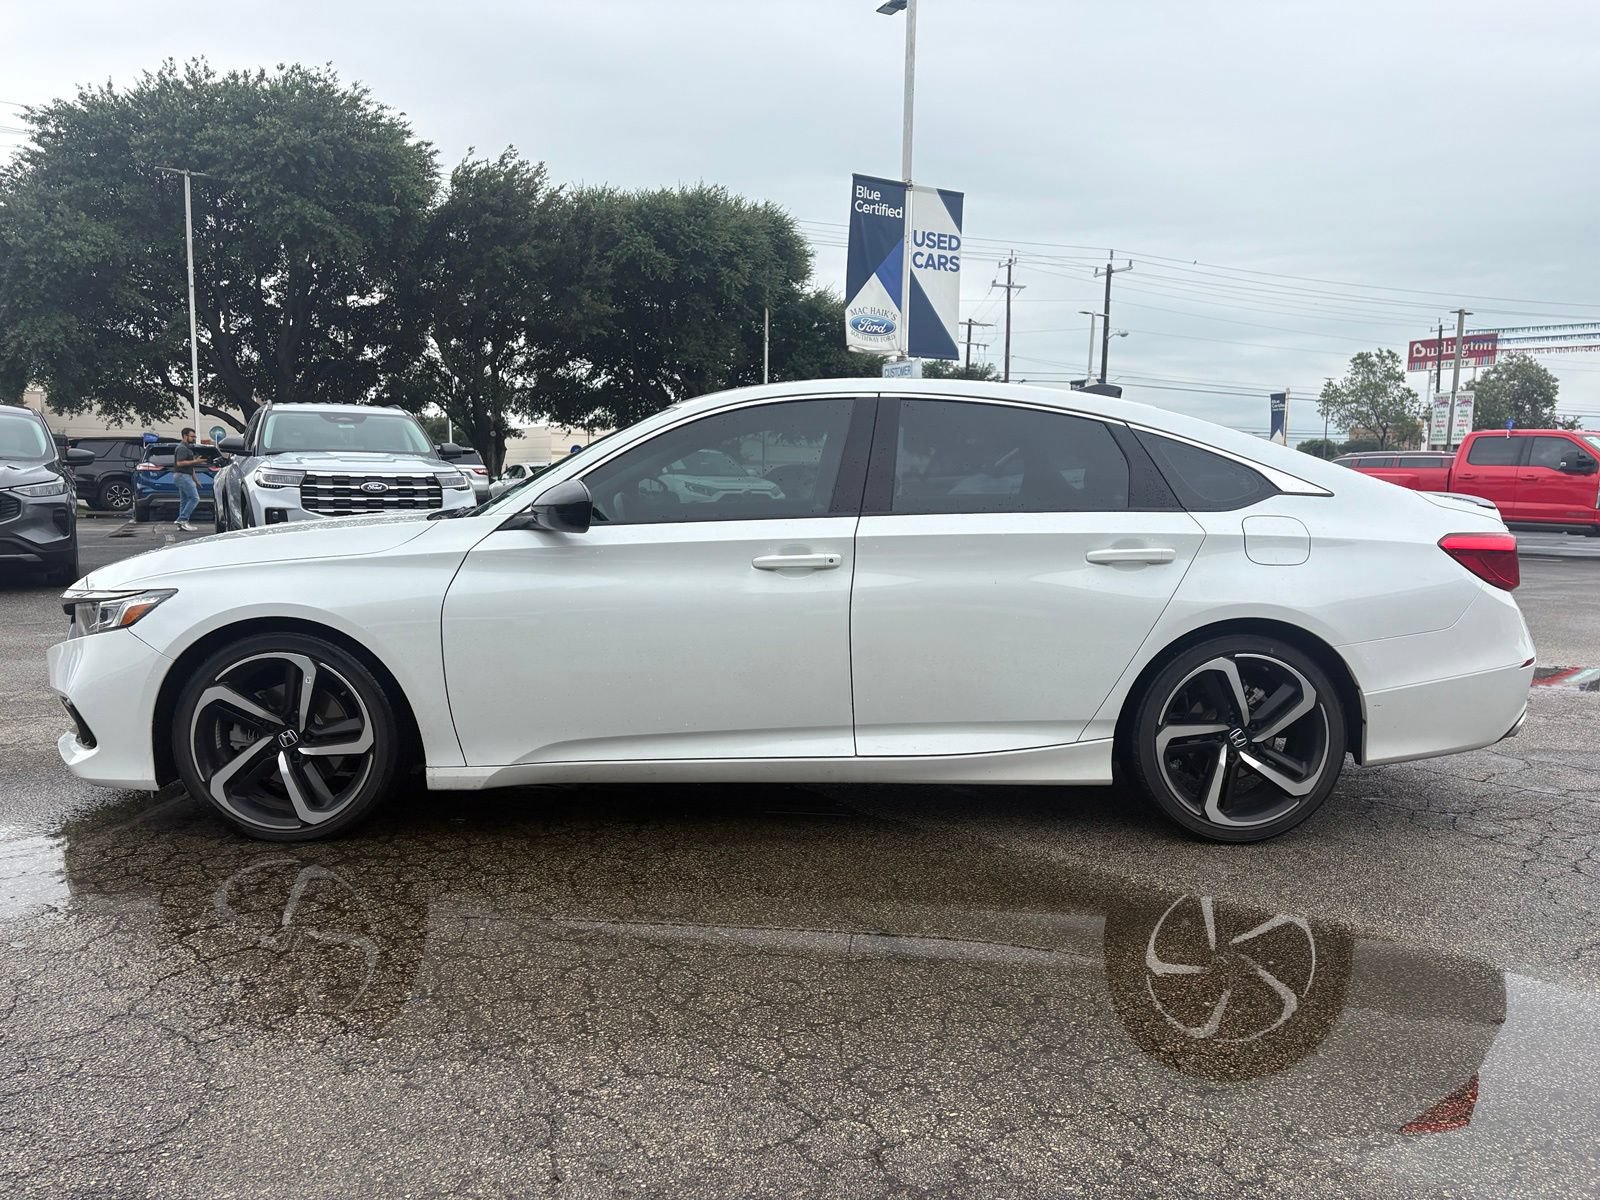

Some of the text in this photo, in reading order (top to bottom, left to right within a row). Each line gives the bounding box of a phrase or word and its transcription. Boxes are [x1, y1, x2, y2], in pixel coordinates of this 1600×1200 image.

[856, 185, 881, 200] Blue
[855, 200, 903, 218] Certified
[913, 230, 961, 252] USED
[912, 252, 960, 273] CARS
[850, 306, 898, 321] MAC HAIK'S
[858, 318, 887, 333] Ford
[1413, 341, 1492, 357] Buligton
[1432, 361, 1454, 369] Prty
